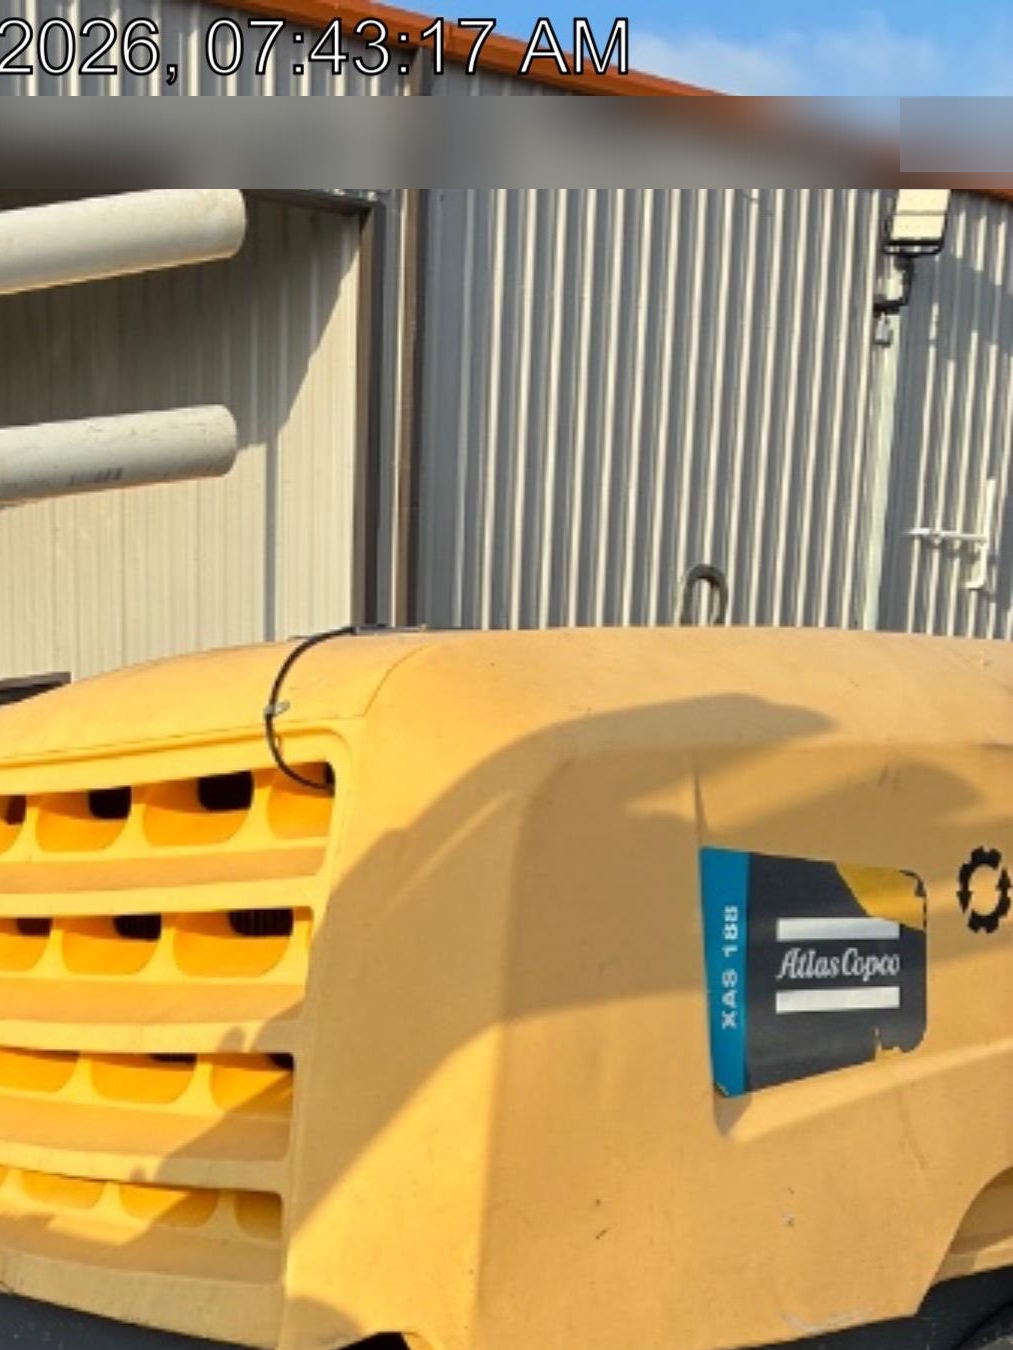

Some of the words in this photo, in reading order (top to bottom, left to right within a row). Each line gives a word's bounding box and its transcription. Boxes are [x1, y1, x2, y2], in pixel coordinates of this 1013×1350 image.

[721, 905, 738, 957] 188
[775, 947, 840, 980] Atlas
[841, 947, 900, 982] Copco
[721, 969, 738, 1029] XAS
